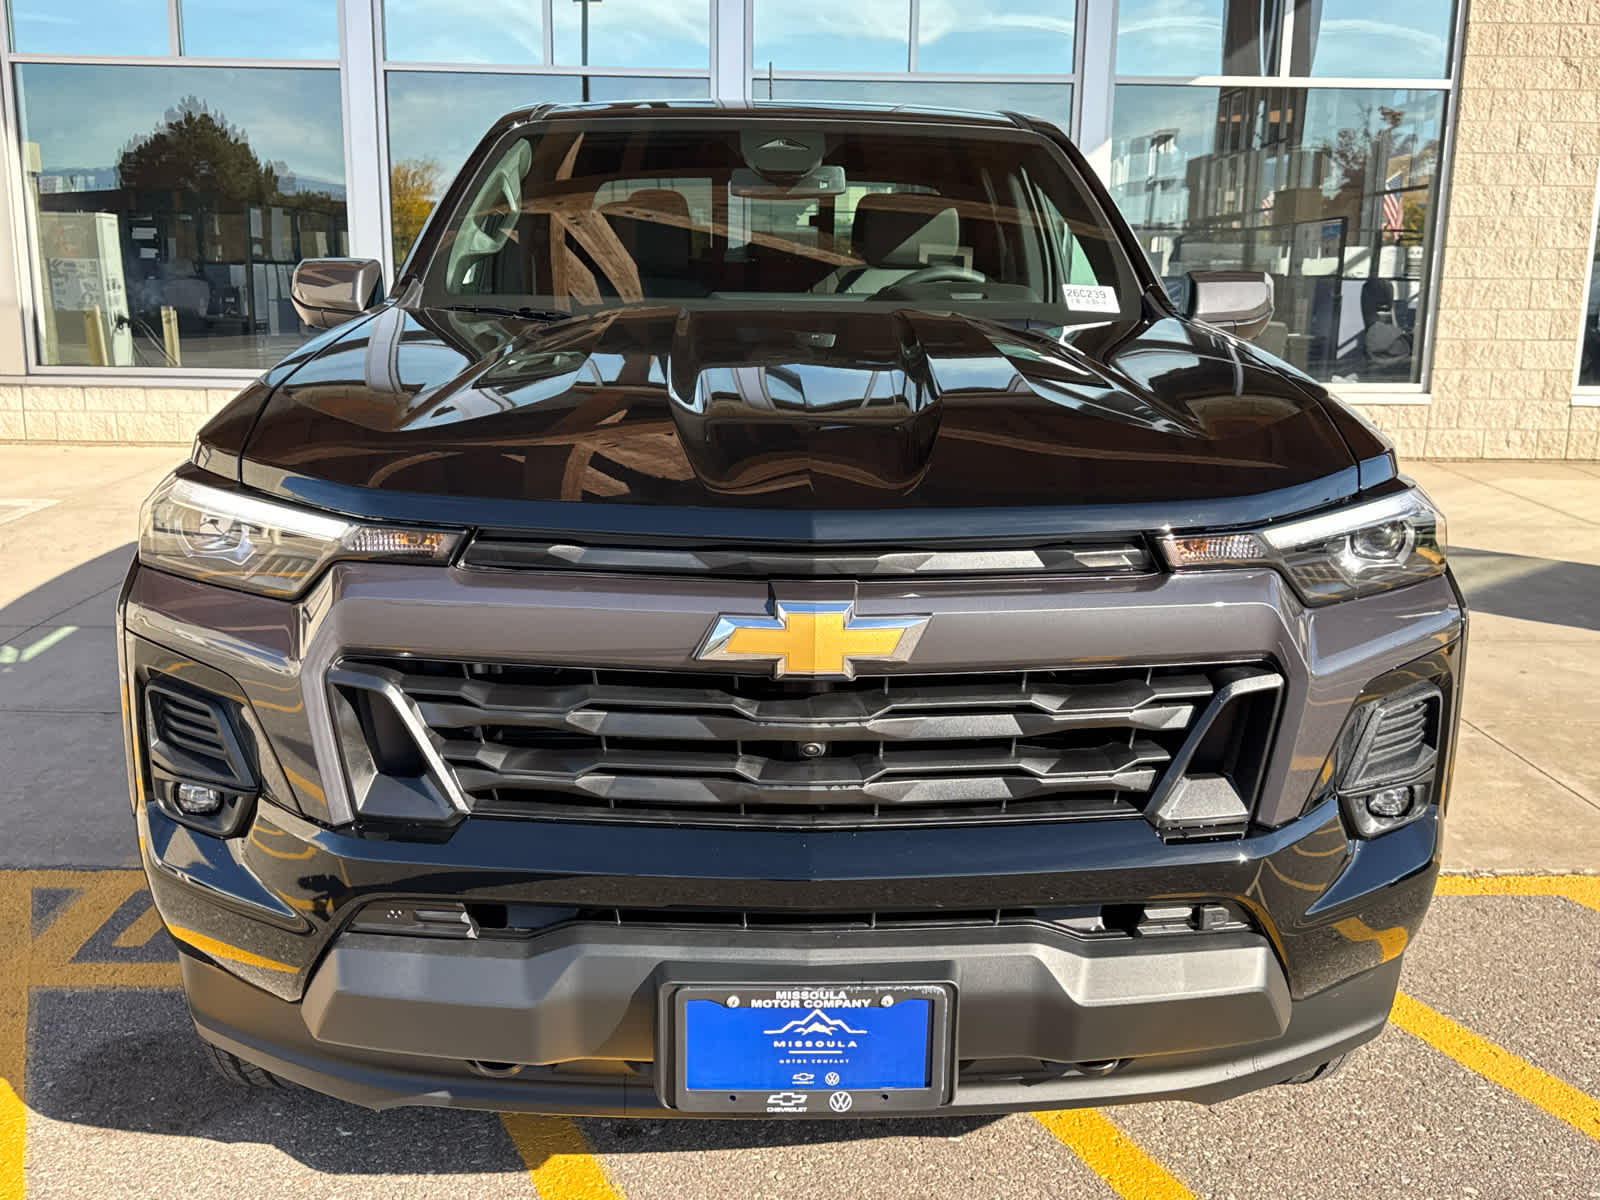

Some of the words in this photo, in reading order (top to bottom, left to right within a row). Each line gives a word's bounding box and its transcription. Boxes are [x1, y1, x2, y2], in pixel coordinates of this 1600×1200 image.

[1066, 289, 1106, 299] 26C239
[775, 991, 847, 1000] MISSOULA
[750, 999, 801, 1008] MOTOR
[803, 999, 871, 1008] COMPANY
[773, 1040, 858, 1048] MISSOULA
